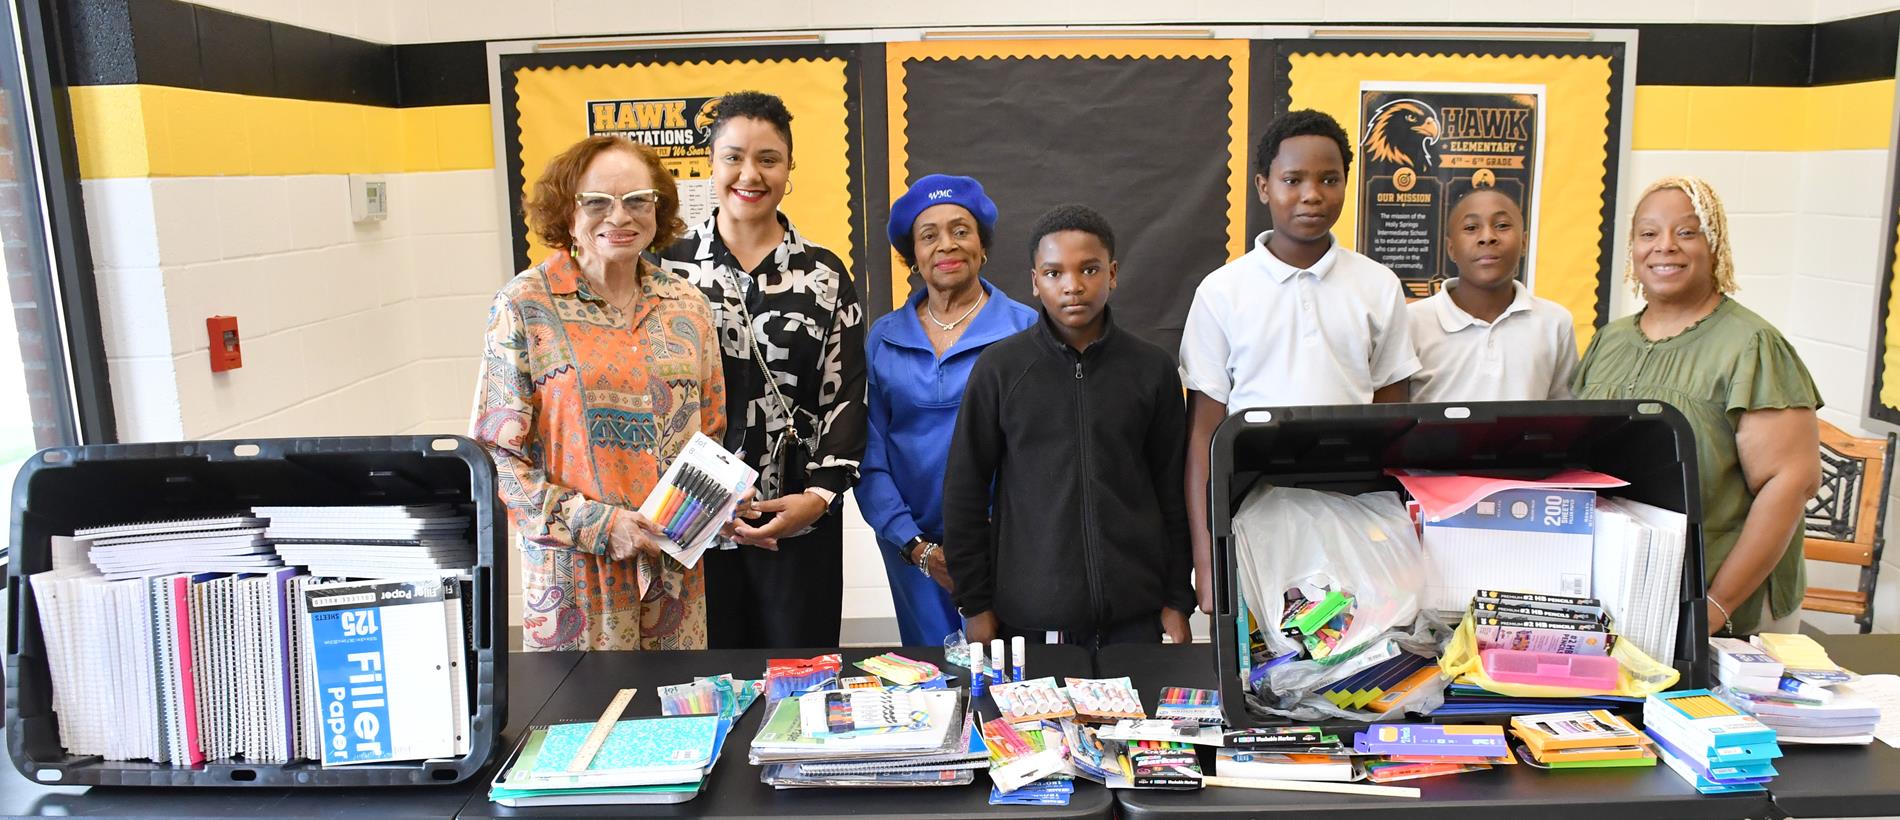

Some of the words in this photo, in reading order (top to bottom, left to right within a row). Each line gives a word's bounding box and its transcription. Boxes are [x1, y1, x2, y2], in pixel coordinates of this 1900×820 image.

[593, 101, 686, 130] HAWK
[1440, 107, 1529, 141] HAWK
[594, 129, 694, 145] CTATIONS
[1450, 141, 1517, 152] ELEMENTARY
[1486, 158, 1512, 166] GRADE
[928, 188, 953, 200] WMC
[1377, 193, 1395, 202] OUR
[1397, 193, 1431, 203] MISSION
[1399, 221, 1418, 229] Springs
[1544, 495, 1562, 526] 200
[1561, 499, 1570, 524] SHEETS
[381, 588, 412, 600] Paper
[413, 585, 437, 598] Filler
[314, 597, 338, 605] RULED
[342, 593, 375, 603] COLLEGE
[315, 613, 340, 621] SHEETS
[1544, 611, 1570, 619] PENCILS
[341, 609, 379, 636] 125
[347, 651, 385, 756] Filler
[327, 687, 349, 760] Paper
